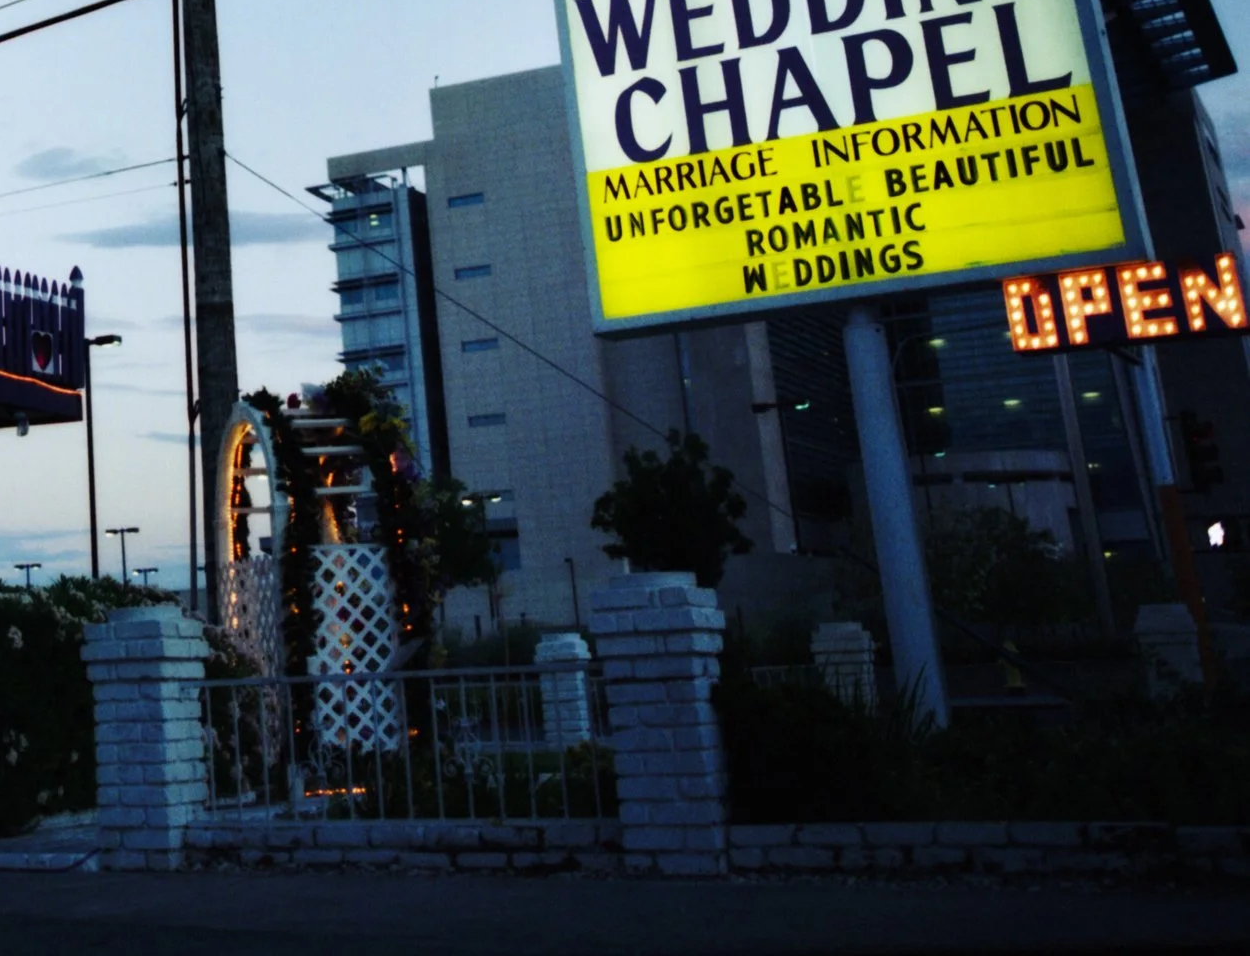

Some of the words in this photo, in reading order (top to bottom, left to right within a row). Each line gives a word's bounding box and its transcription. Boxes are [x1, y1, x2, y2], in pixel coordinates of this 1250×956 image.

[614, 2, 1073, 163] CHAPEL
[603, 147, 778, 203] MARRIAGE
[812, 95, 1082, 168] INFORMATION
[605, 175, 865, 242] UNFORGETABLE
[884, 137, 1095, 197] BEAUTIFUL
[742, 240, 925, 294] WEDDINGS
[746, 202, 925, 257] ROMANTIC
[1002, 252, 1249, 352] OPEN
